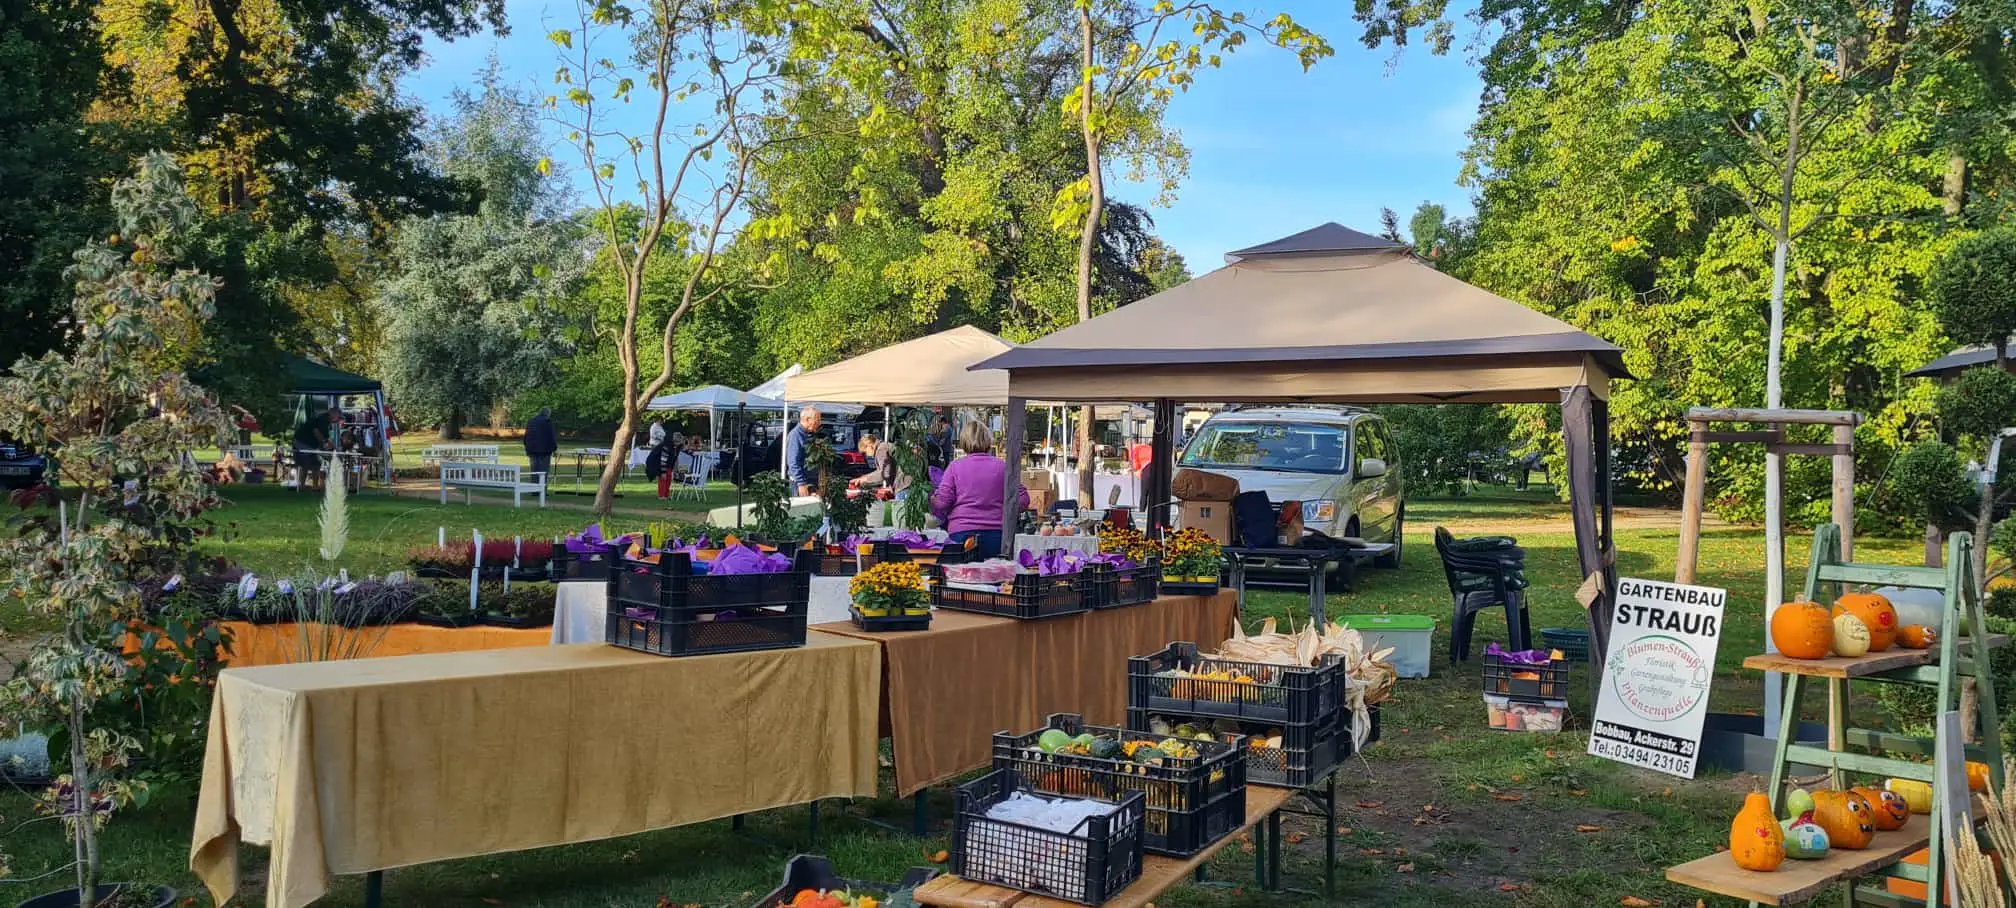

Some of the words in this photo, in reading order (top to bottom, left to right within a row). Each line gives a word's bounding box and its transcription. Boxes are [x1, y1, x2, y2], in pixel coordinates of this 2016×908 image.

[1620, 582, 1722, 607] GARTENBAU
[1617, 604, 1716, 637] STRAUß
[1627, 642, 1700, 669] Blumen-Strauß
[1596, 722, 1632, 743] Bobbau,
[1634, 731, 1677, 752] Ackerstr.
[1680, 740, 1694, 755] 29
